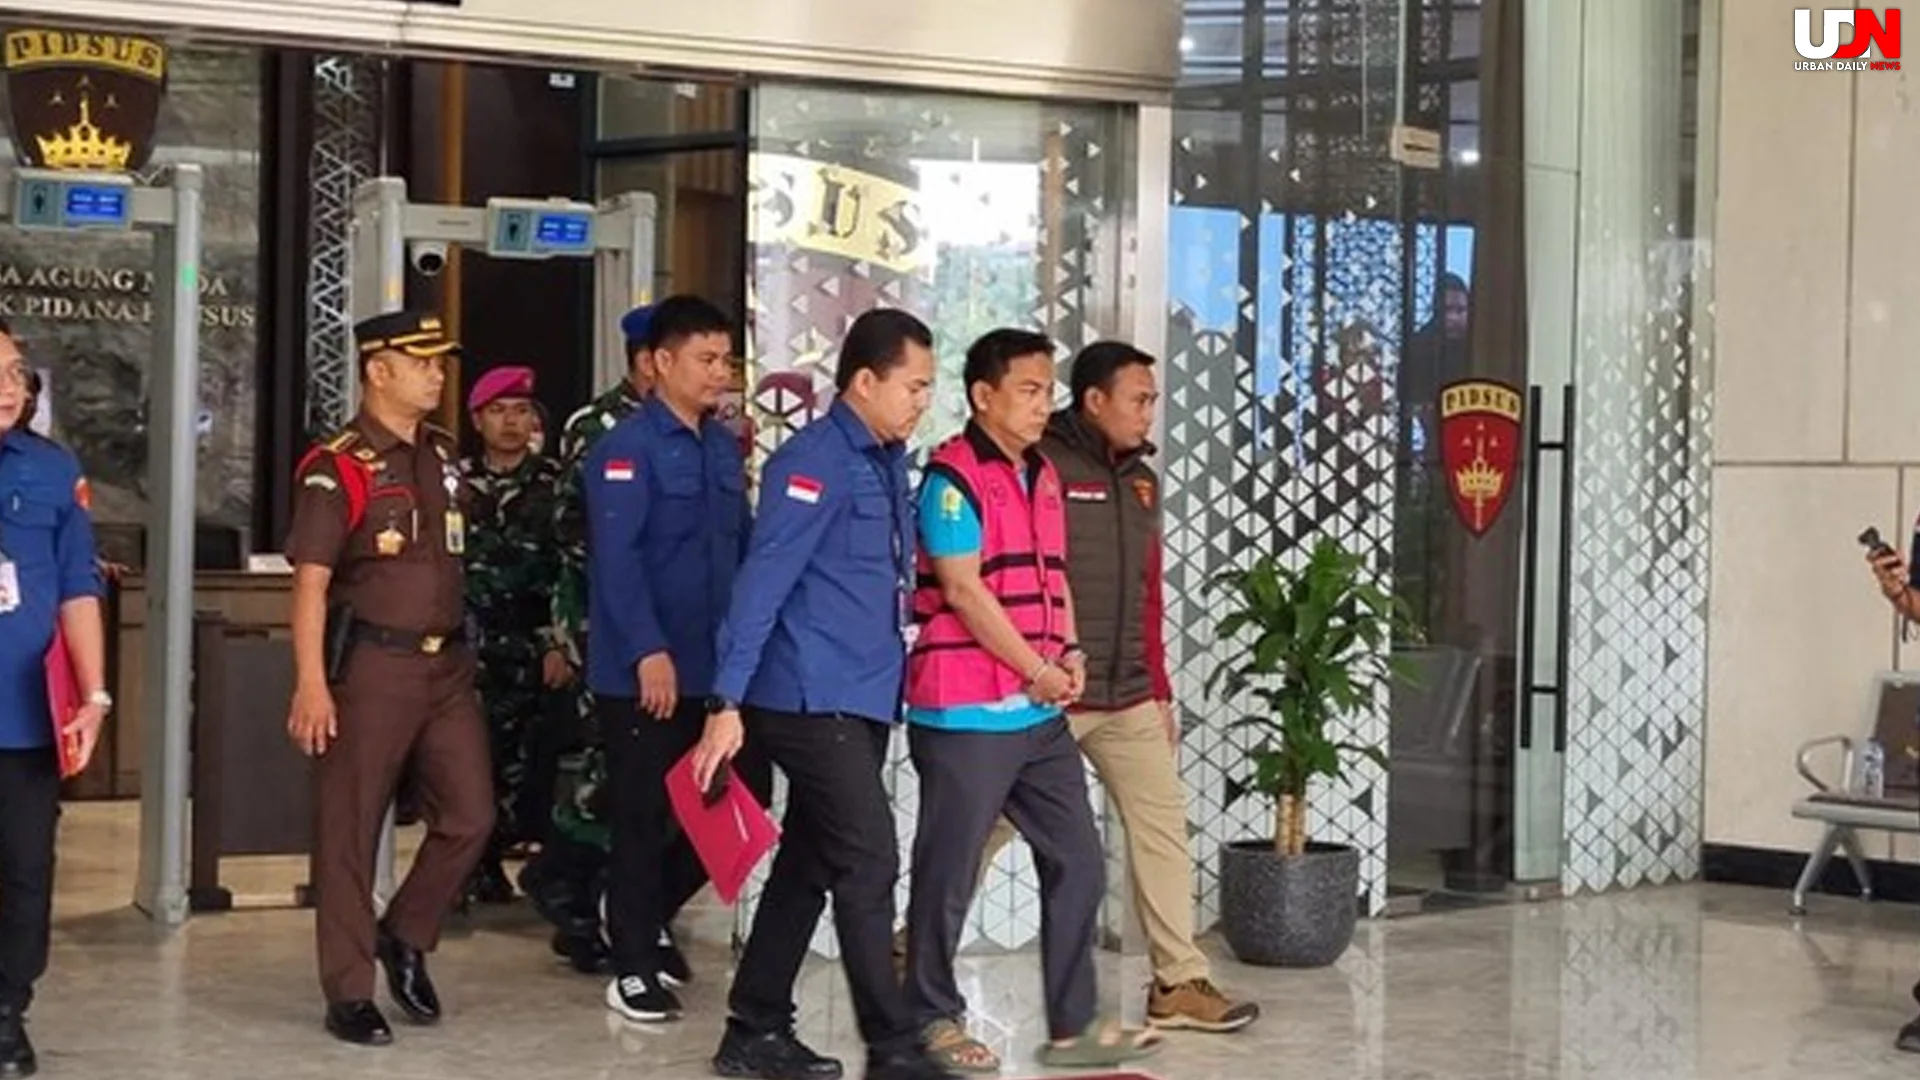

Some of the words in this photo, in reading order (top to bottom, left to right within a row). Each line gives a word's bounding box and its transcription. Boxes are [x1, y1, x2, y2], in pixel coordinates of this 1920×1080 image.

[10, 31, 159, 69] PIDSUS
[26, 266, 134, 291] AGUNG
[24, 296, 138, 320] PIDANA
[1446, 387, 1517, 412] PIDSUS
